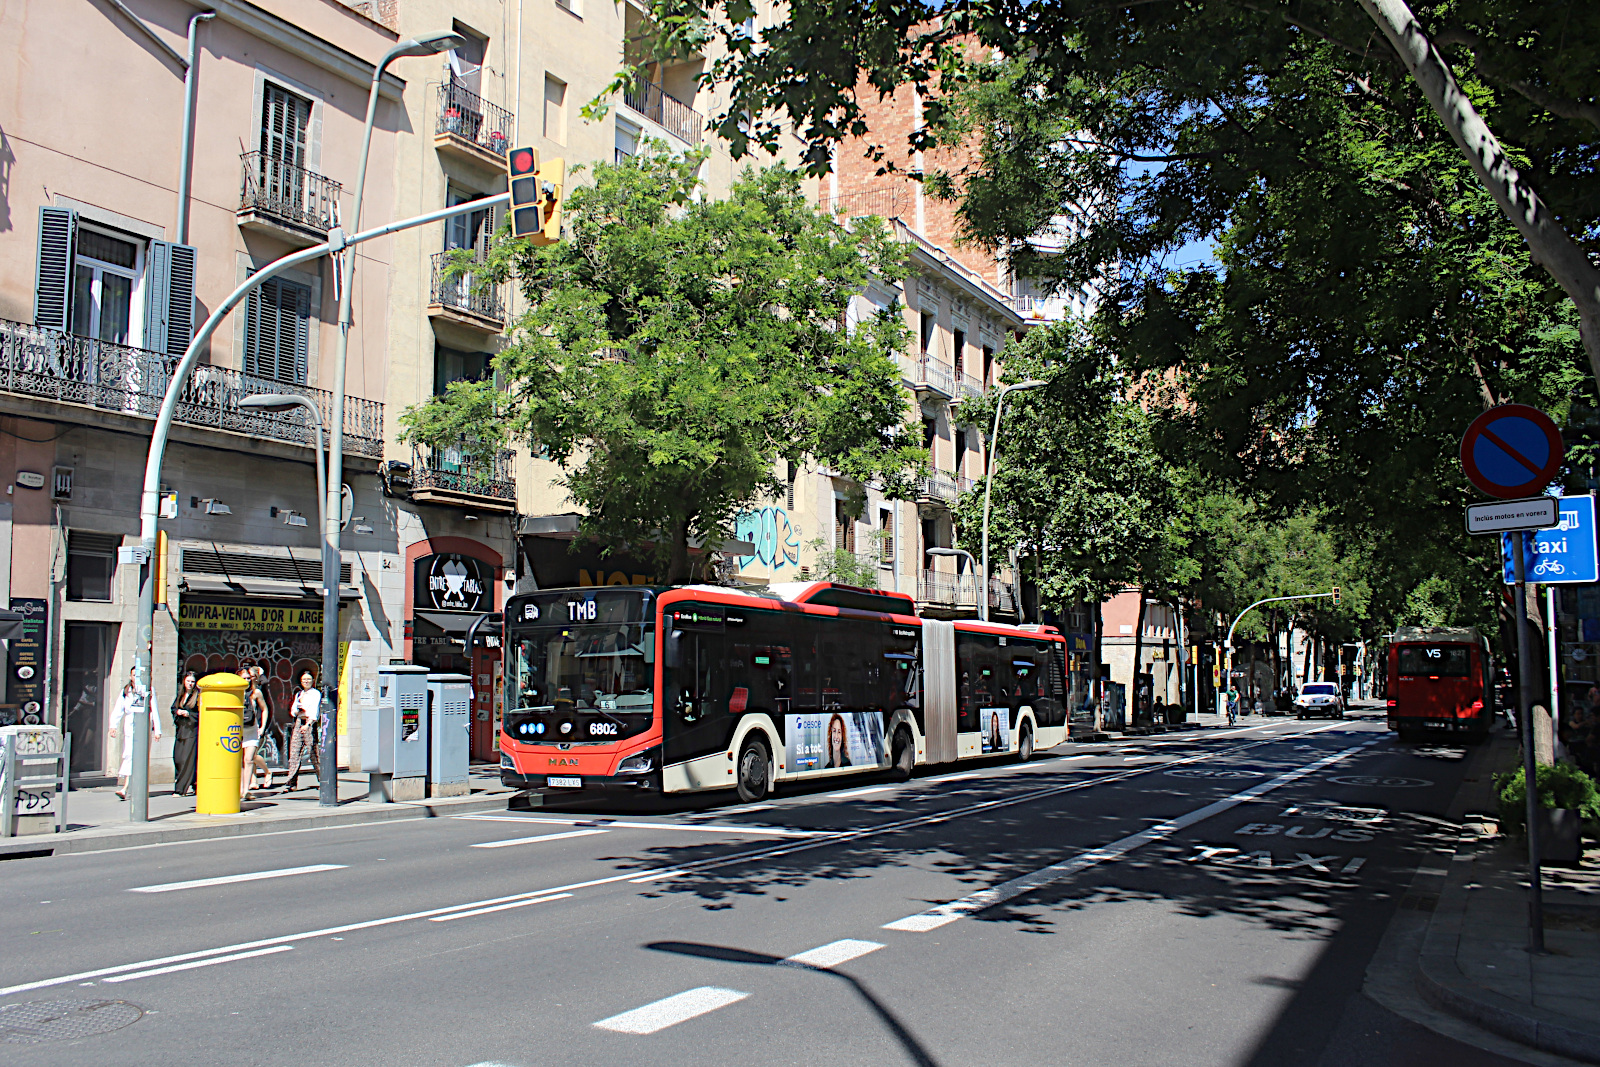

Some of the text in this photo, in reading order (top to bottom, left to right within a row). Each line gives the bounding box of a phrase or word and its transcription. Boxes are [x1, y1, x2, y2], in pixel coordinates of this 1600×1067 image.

[1474, 514, 1494, 522] Inclús
[1530, 537, 1567, 554] taxi
[429, 576, 483, 594] ENTRE TABLAS
[180, 603, 324, 624] OMPRA-VENDA D'OR I ARGE
[567, 600, 597, 621] TMB
[243, 622, 252, 631] 93
[252, 622, 265, 631] 298
[266, 623, 276, 631] 07
[275, 623, 284, 631] 26
[1425, 648, 1442, 659] V5
[589, 723, 618, 735] 6802
[548, 758, 579, 766] MAN
[14, 789, 51, 810] FDS
[1234, 822, 1375, 842] BUS
[1188, 845, 1368, 874] TAXI
